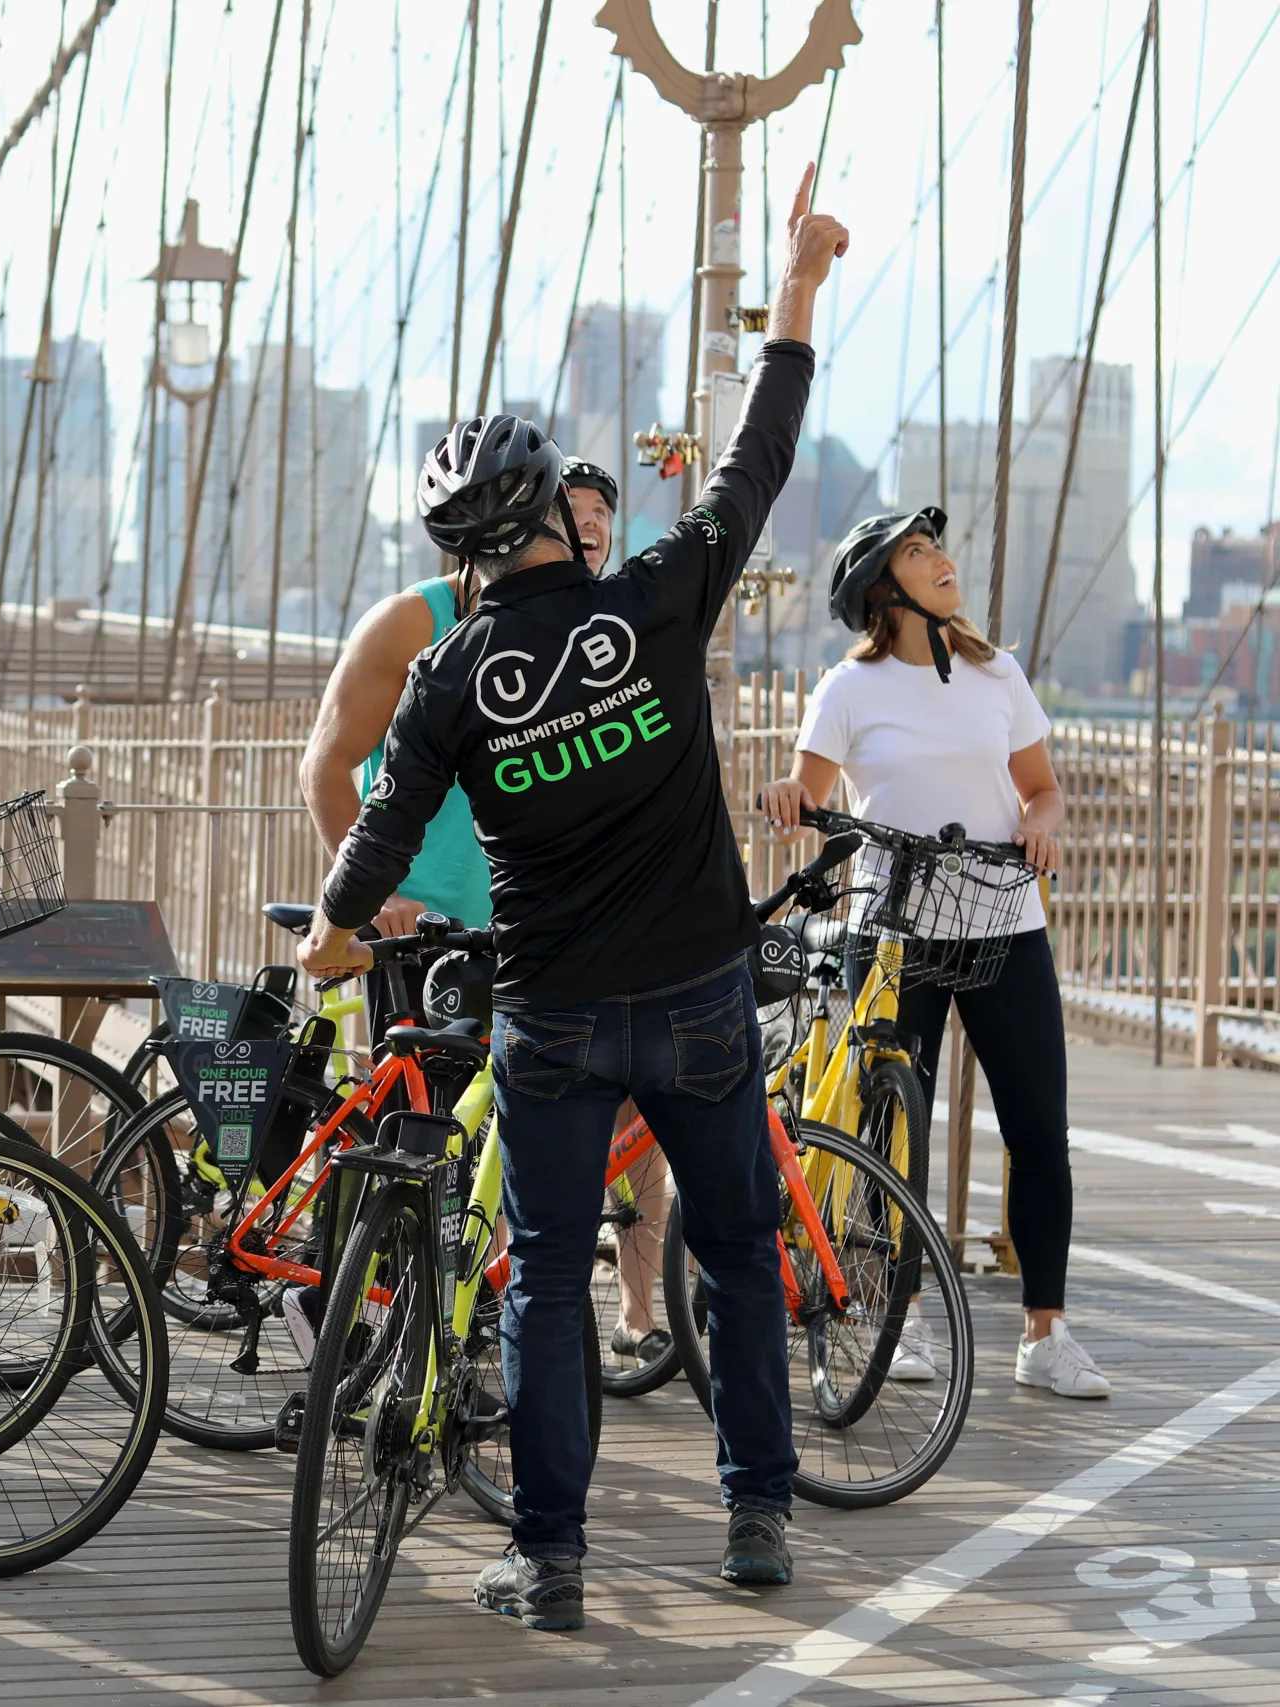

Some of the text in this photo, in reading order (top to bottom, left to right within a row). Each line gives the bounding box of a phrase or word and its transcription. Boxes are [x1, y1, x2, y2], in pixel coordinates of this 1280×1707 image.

[488, 678, 652, 752] UNLIMITED BIKING
[494, 698, 671, 792] GUIDE
[181, 1005, 228, 1019] ONE HOUR
[178, 1016, 227, 1040] FREE
[199, 1068, 268, 1079] ONE HOUR
[198, 1081, 267, 1102] FREE
[440, 1213, 460, 1245] FREE
